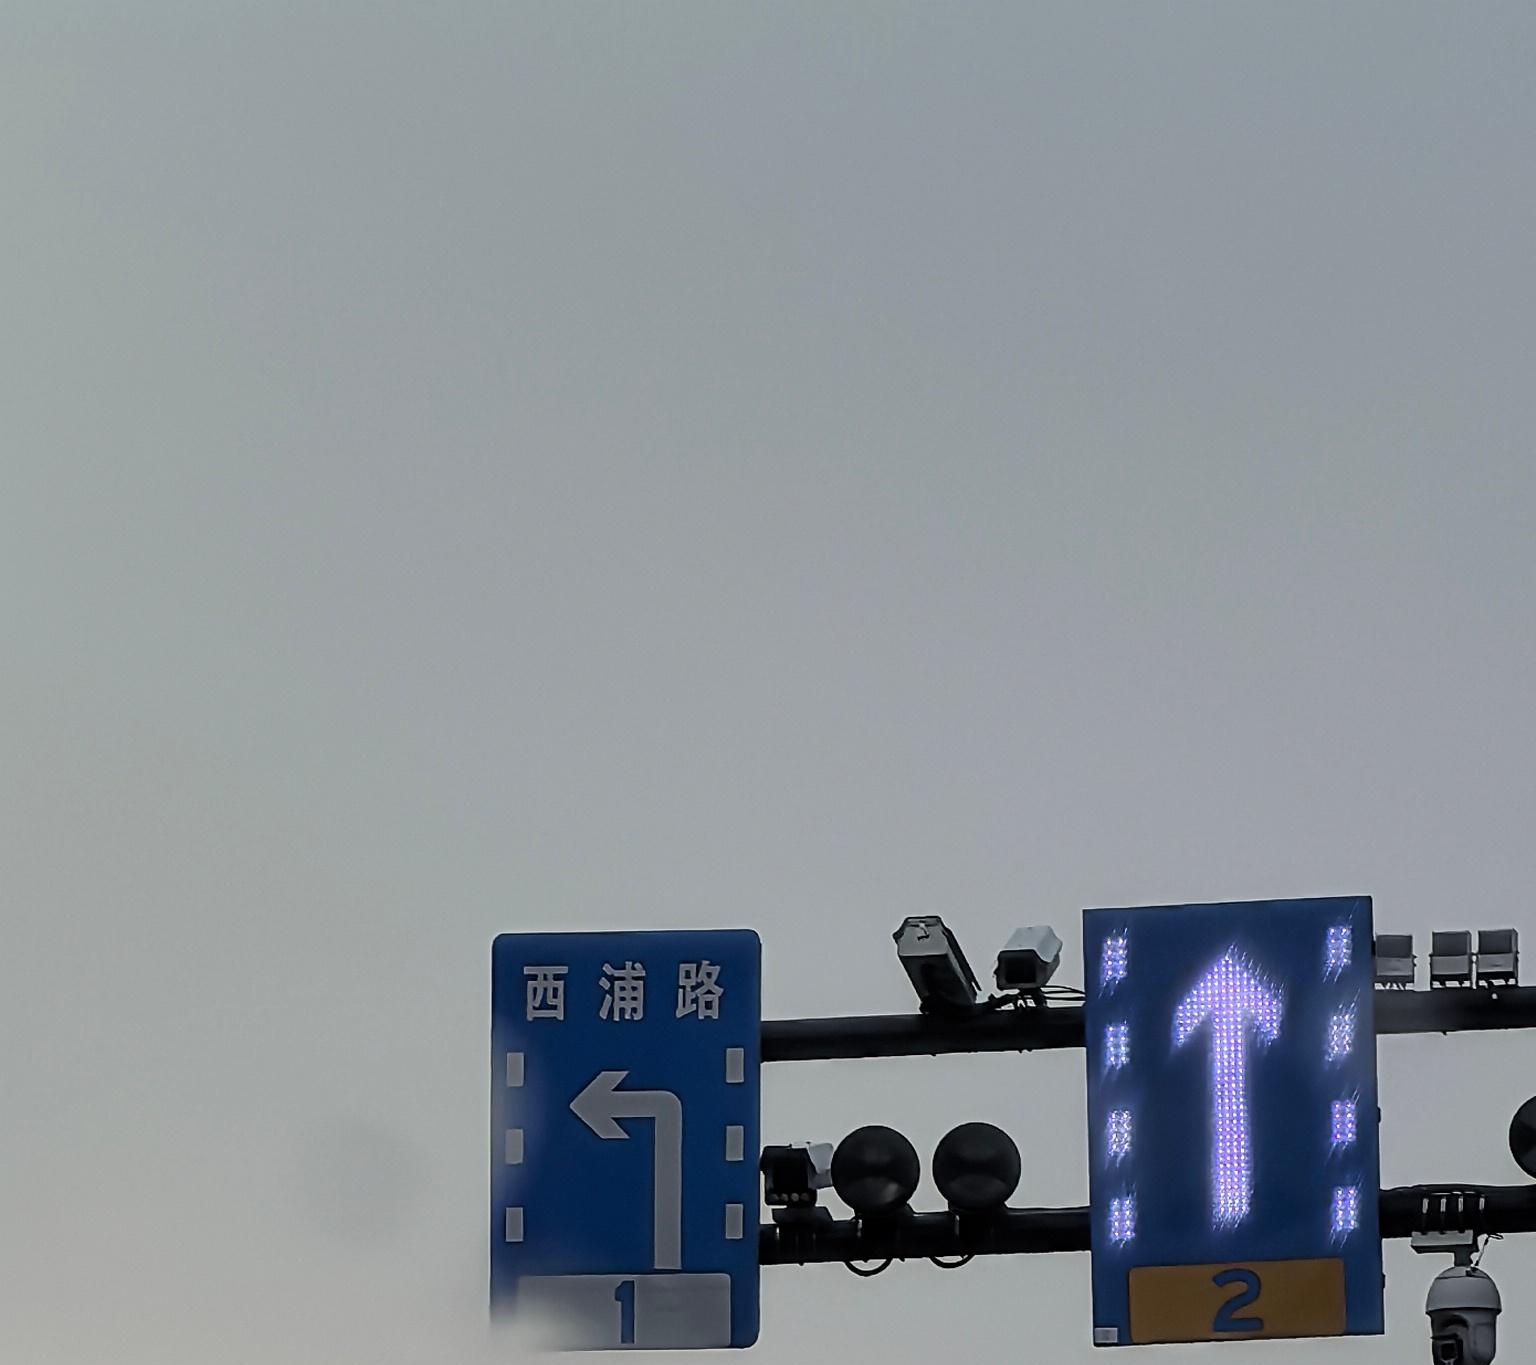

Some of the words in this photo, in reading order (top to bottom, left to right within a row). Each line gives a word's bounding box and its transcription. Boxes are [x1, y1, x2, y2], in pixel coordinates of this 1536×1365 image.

[523, 960, 725, 1022] 西浦路
[614, 1279, 636, 1345] 1
[1211, 1268, 1264, 1332] 2
